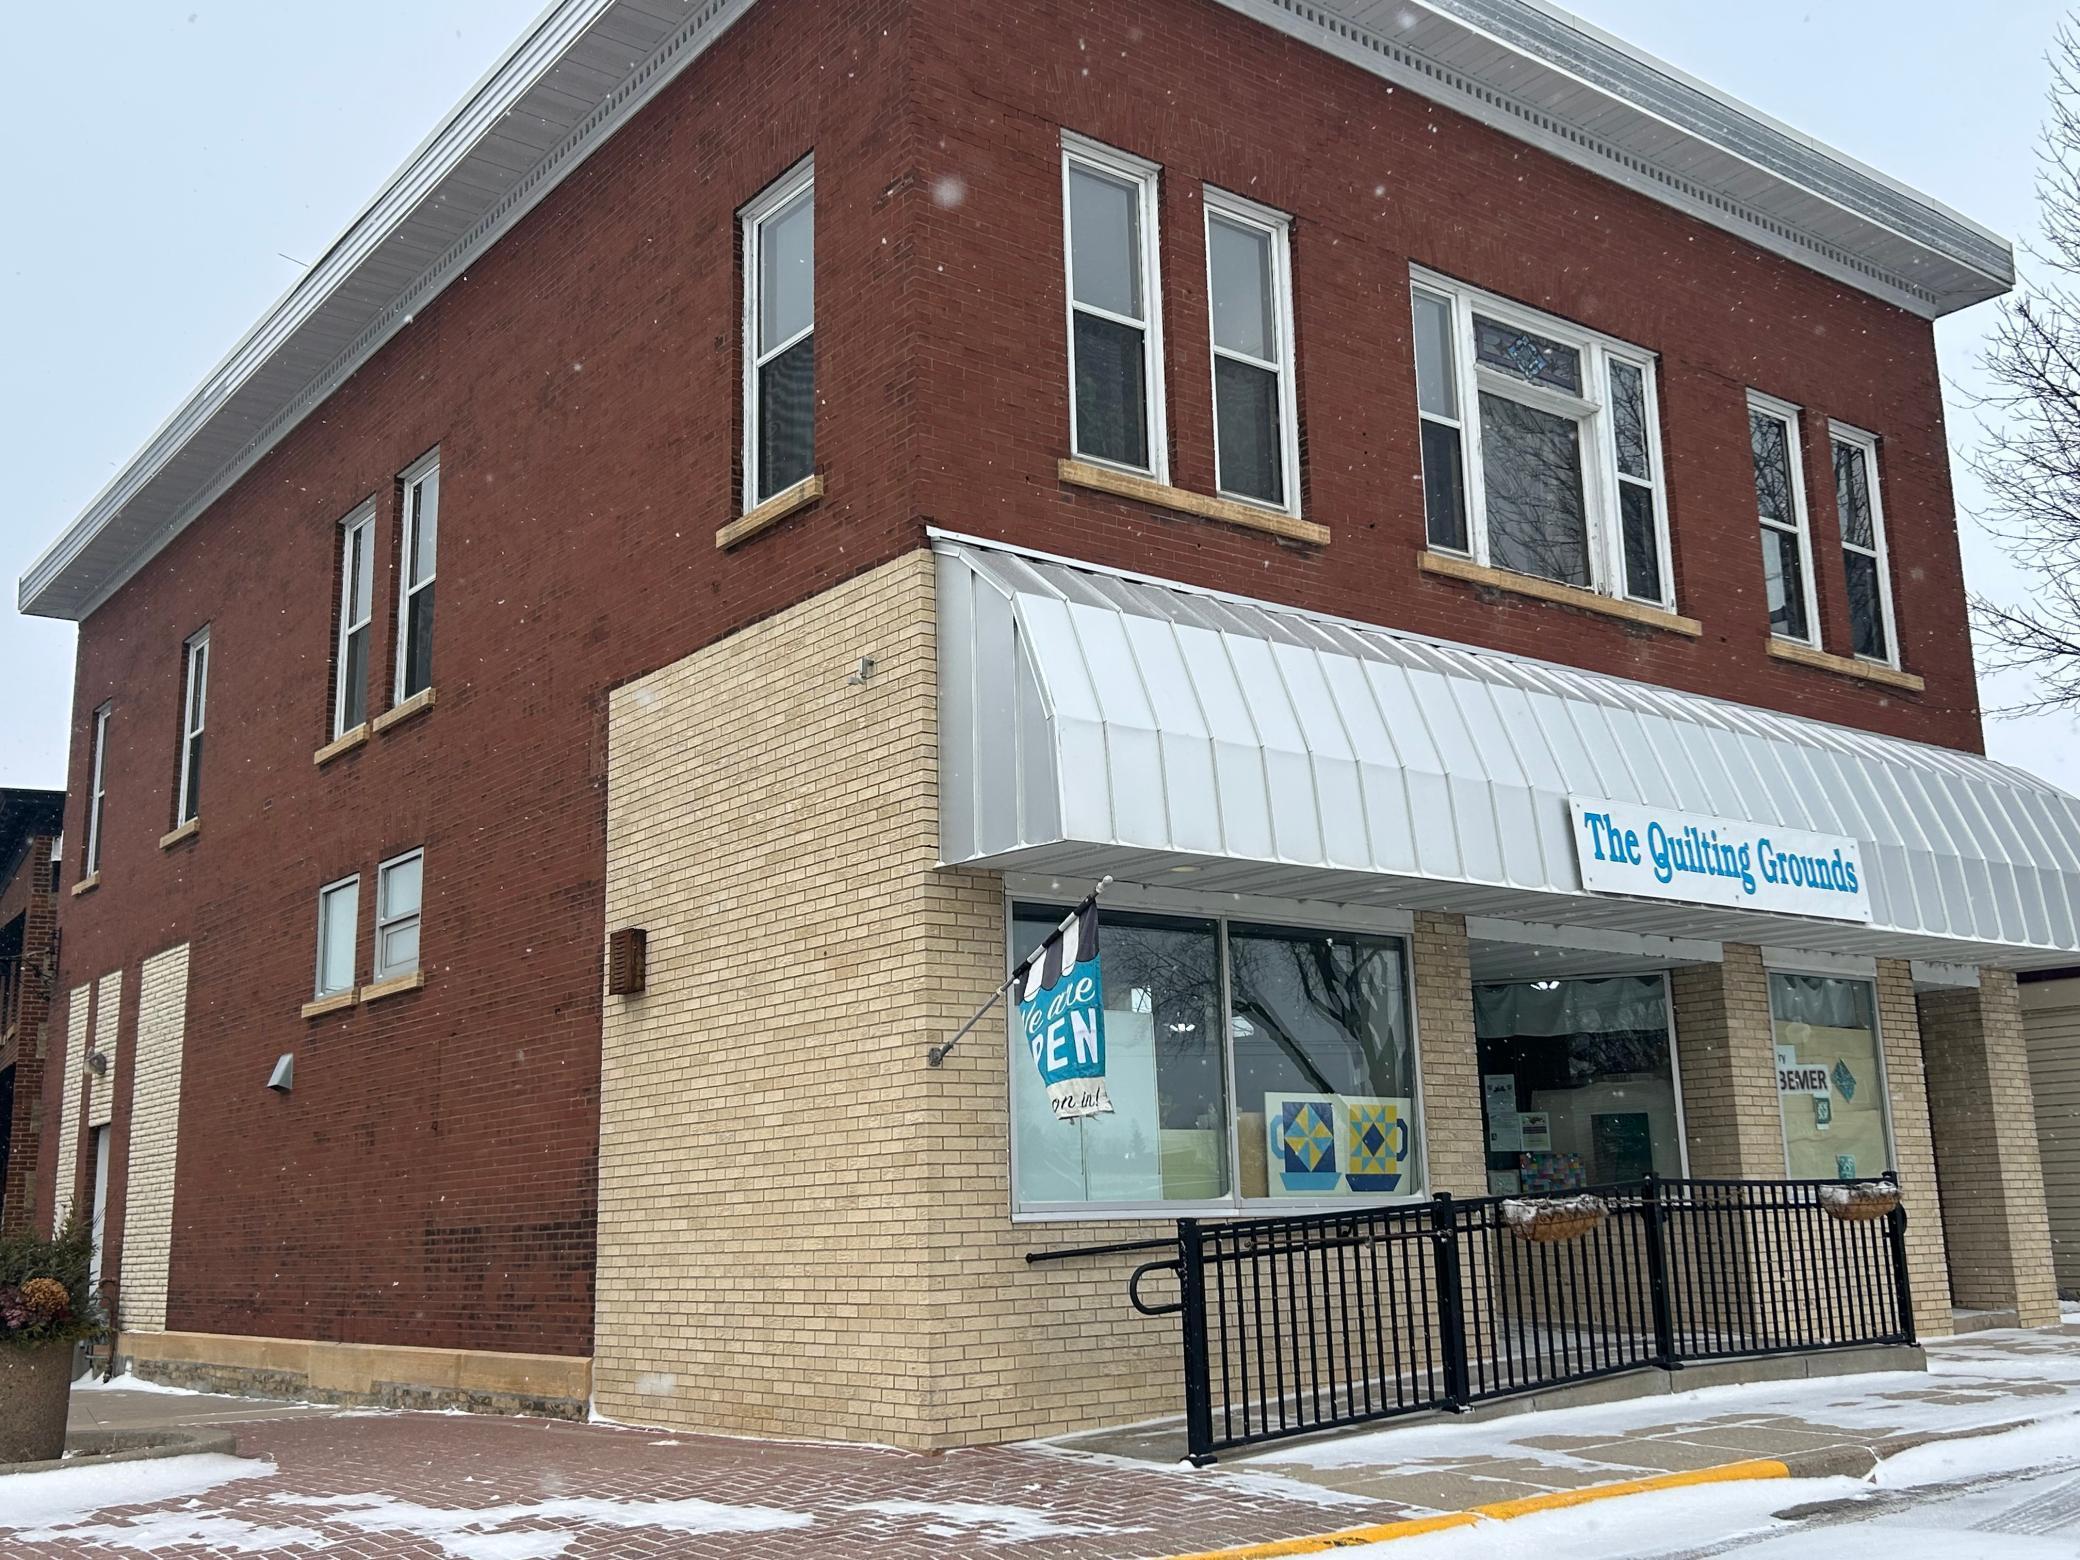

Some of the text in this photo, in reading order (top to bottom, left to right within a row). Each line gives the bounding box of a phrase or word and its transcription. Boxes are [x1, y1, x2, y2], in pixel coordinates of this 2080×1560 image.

[1584, 811, 1859, 896] The Quilting Grounds
[1047, 977, 1096, 1021] are
[1031, 1007, 1098, 1073] PEN
[1051, 1086, 1101, 1113] on in!
[1778, 1069, 1829, 1091] BEMER
